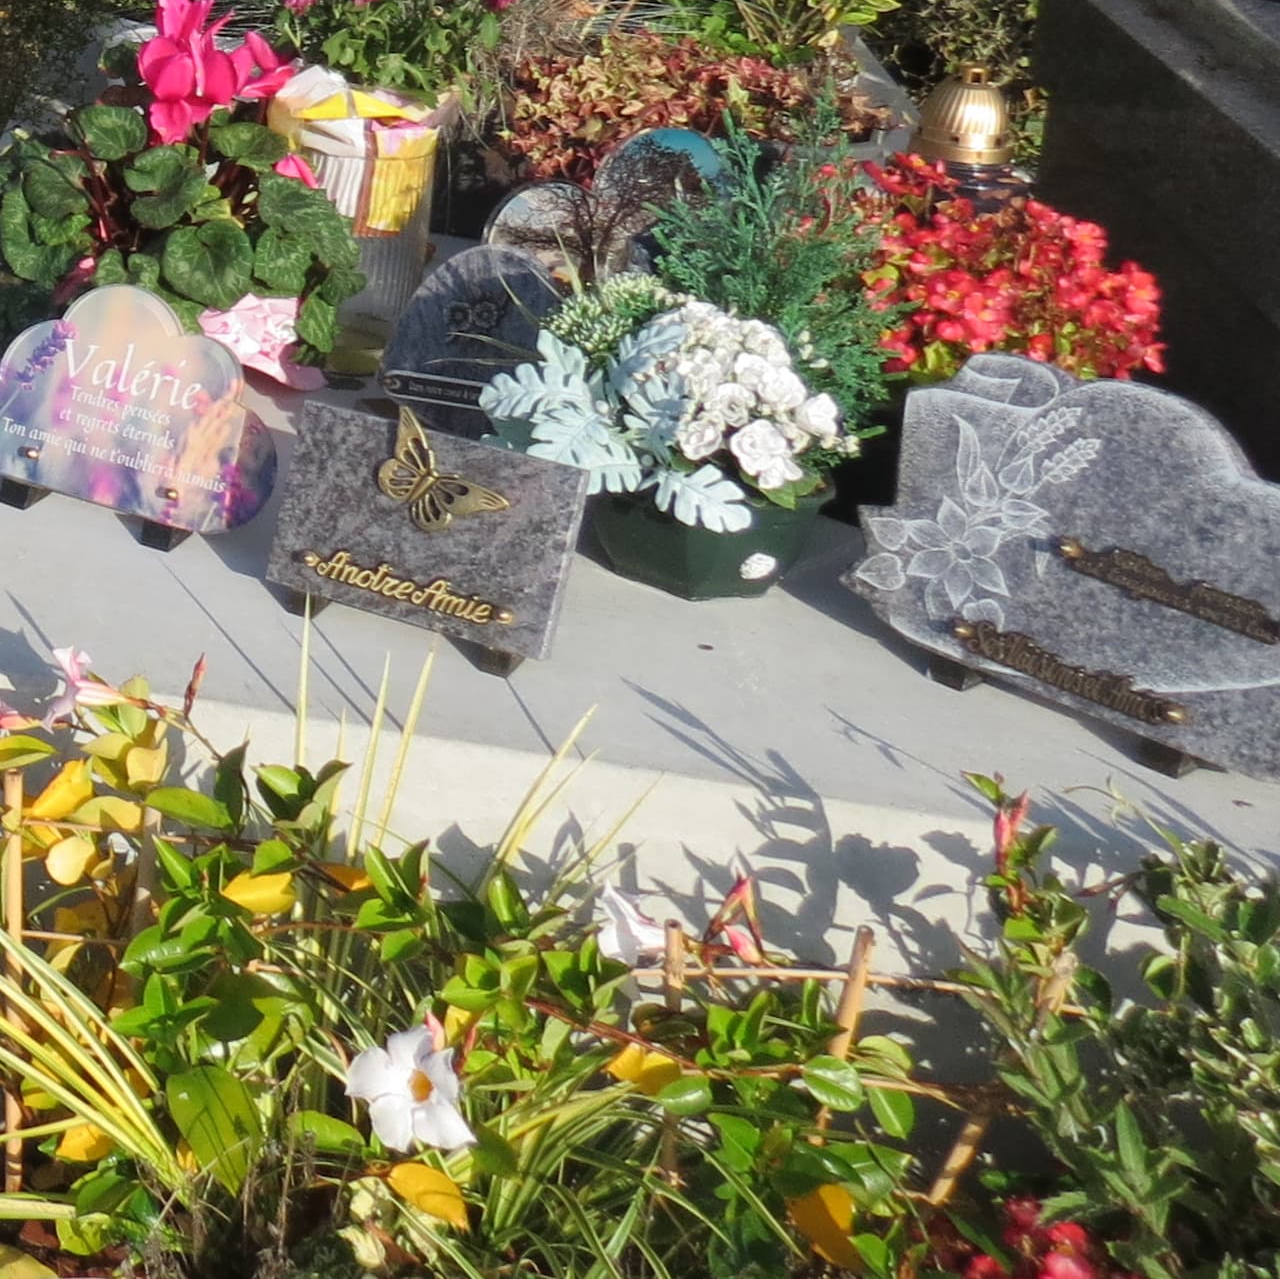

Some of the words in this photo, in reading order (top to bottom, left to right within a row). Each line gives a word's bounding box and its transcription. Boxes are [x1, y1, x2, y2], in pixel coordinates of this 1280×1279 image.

[63, 337, 203, 411] Valérie
[70, 384, 121, 412] Tendres
[121, 399, 172, 426] pensées
[58, 407, 70, 422] et
[75, 410, 120, 435] regrets
[121, 420, 176, 450] éternels
[2, 415, 28, 438] Ton
[28, 427, 62, 448] amie
[63, 434, 89, 456] qui
[90, 444, 107, 460] ne
[109, 448, 176, 479] t'oubliera
[174, 468, 227, 494] jamais
[411, 579, 493, 624] Amie
